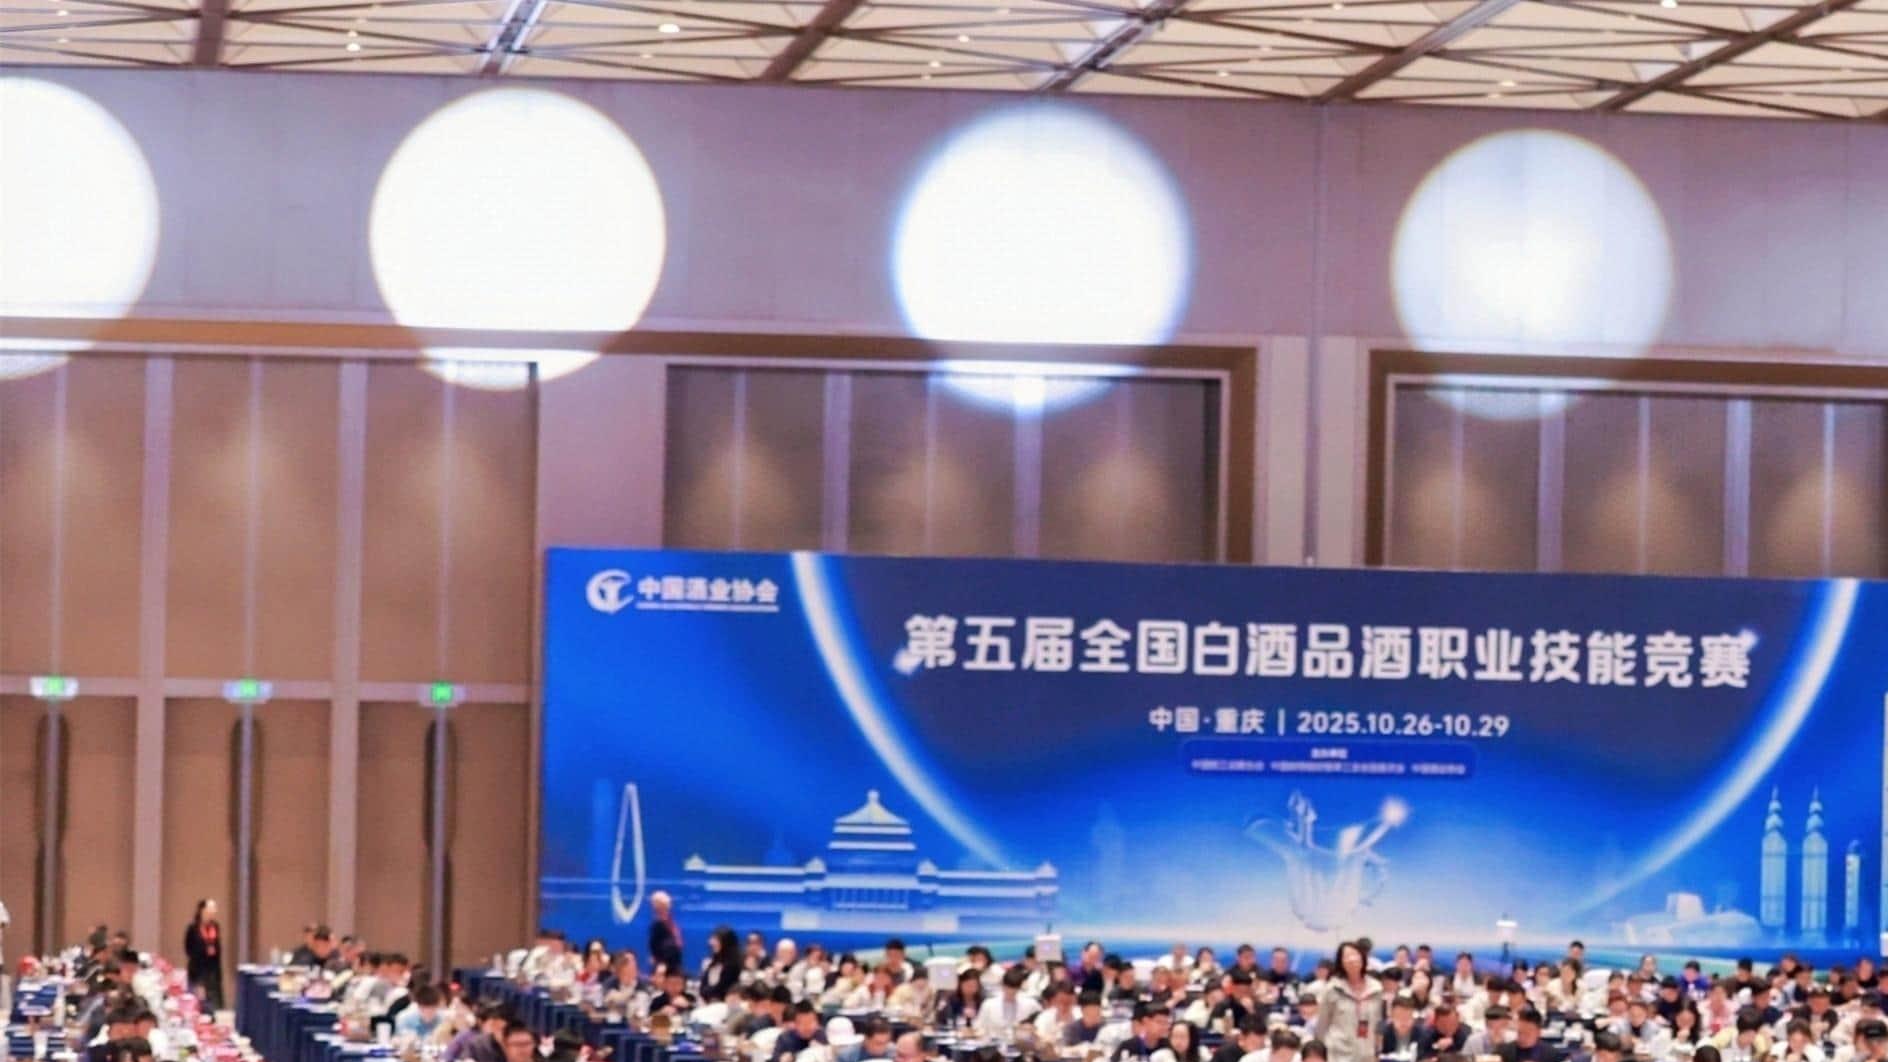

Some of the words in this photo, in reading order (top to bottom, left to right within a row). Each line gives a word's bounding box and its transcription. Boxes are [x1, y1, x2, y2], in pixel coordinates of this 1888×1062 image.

[904, 615, 1752, 688] 第五届全国白酒品酒职业技能竞赛
[1297, 711, 1510, 738] 2025.10.26-10.29
